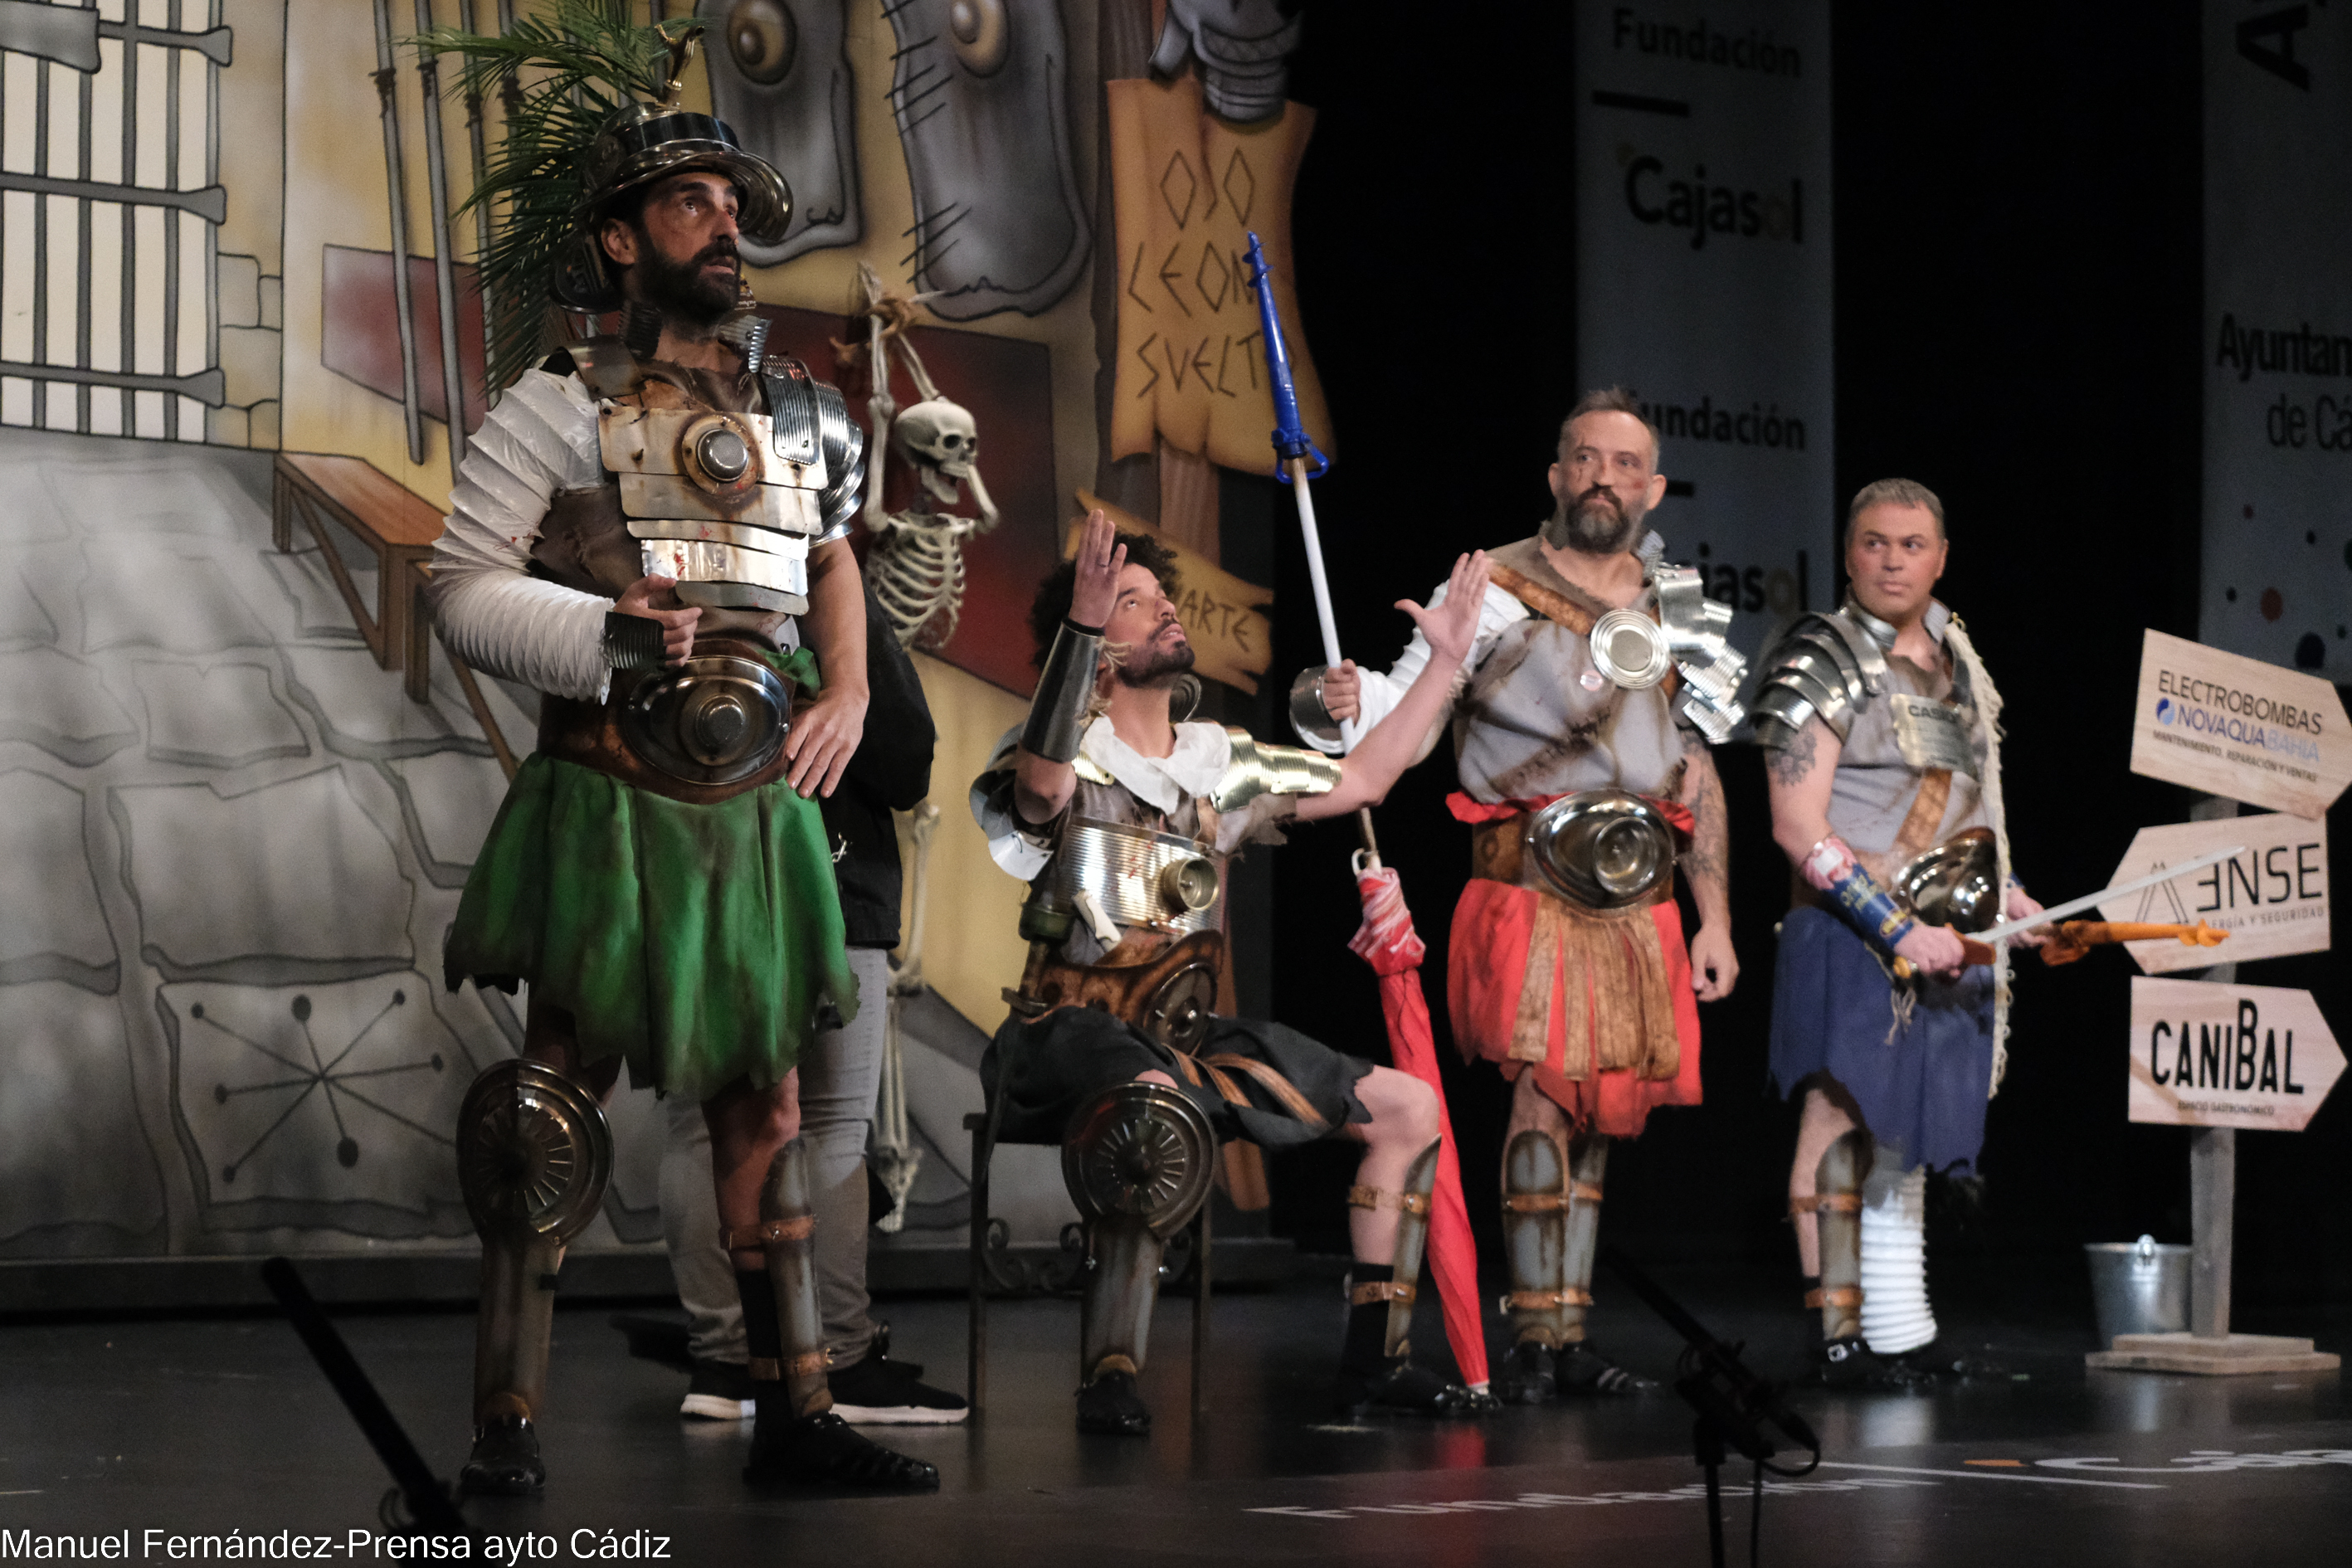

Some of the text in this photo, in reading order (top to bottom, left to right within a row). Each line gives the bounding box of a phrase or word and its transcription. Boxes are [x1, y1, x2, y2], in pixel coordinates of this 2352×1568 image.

[1614, 7, 1801, 78] Fundación
[1625, 155, 1803, 251] Cajasol
[1633, 392, 1805, 450] undación
[2267, 393, 2306, 448] de
[2158, 670, 2323, 736] ELECTROBOMBAS
[2261, 905, 2325, 925] SEGURIDAD
[2151, 997, 2305, 1095] CANIBAL
